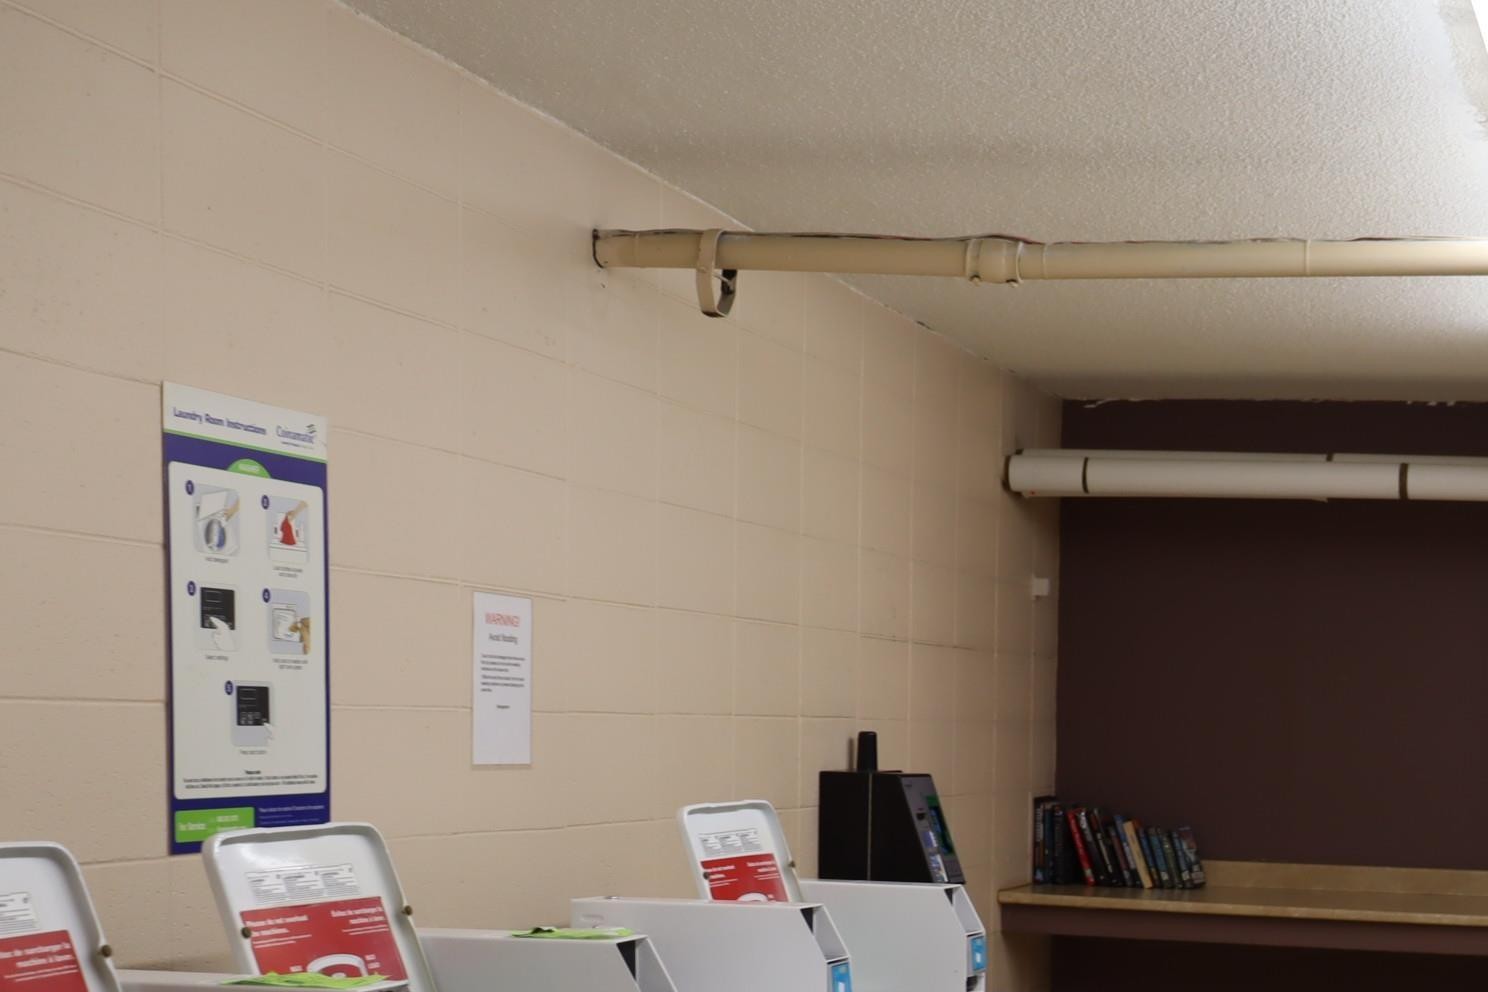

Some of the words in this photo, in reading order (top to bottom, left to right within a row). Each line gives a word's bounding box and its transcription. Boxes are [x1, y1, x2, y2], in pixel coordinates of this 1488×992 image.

[173, 407, 202, 424] Laundry
[205, 413, 224, 427] Room
[226, 417, 267, 436] Instructions
